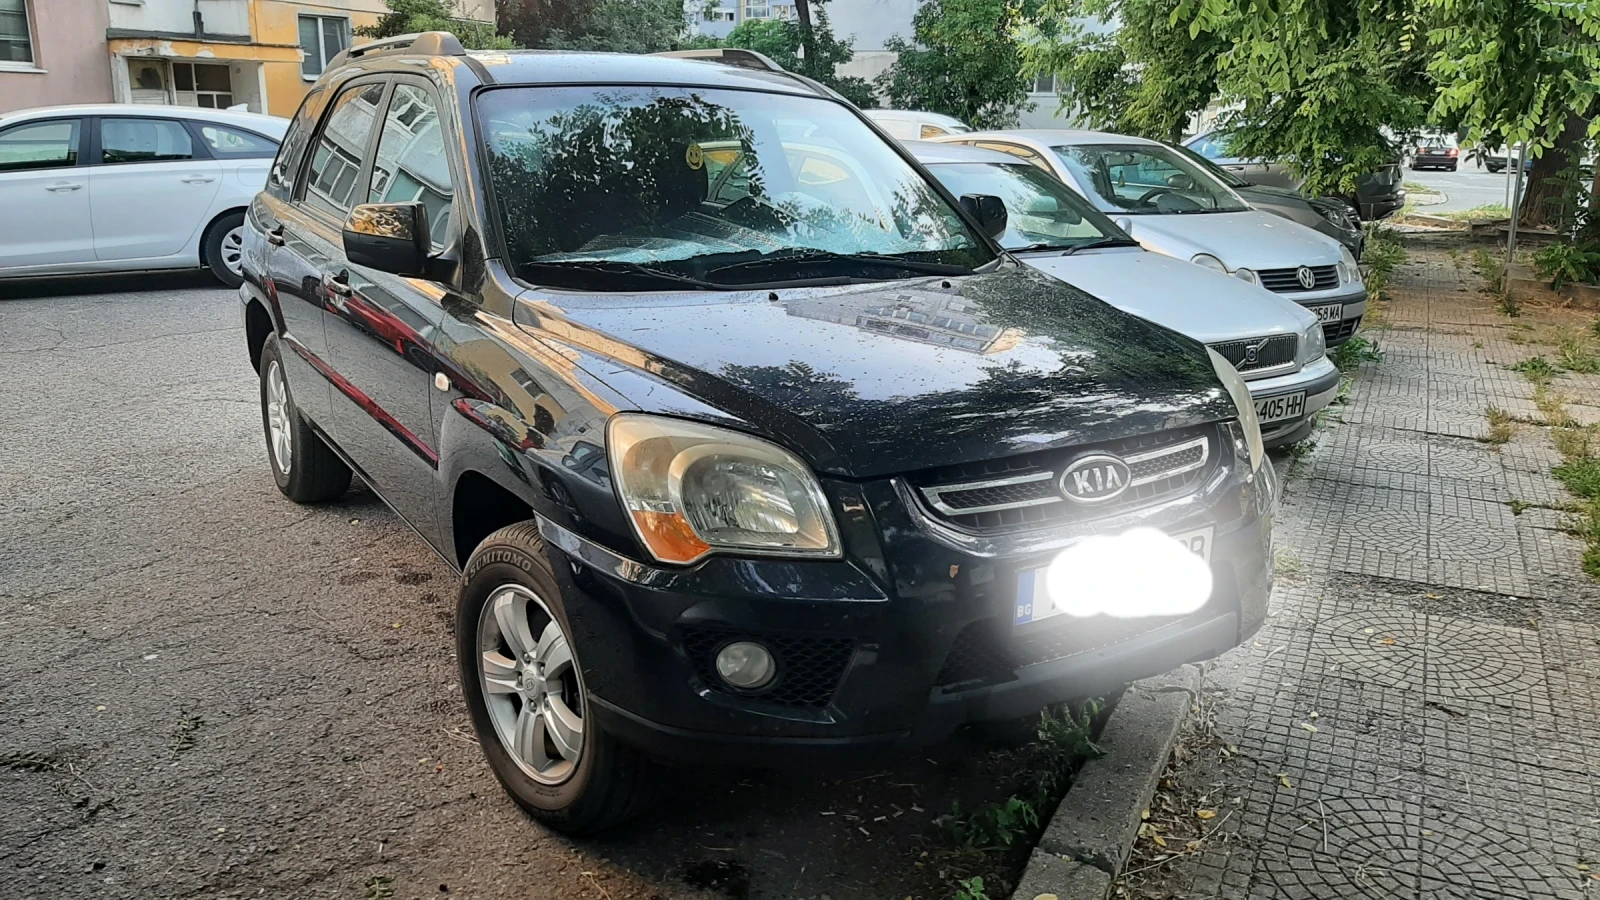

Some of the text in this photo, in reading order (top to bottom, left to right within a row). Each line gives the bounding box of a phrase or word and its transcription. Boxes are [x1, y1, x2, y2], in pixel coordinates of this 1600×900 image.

[1310, 307, 1329, 321] 58
[1285, 394, 1303, 416] HH
[1072, 465, 1122, 495] KIA
[470, 550, 532, 579] SUMITOMO
[1016, 603, 1032, 618] BG
